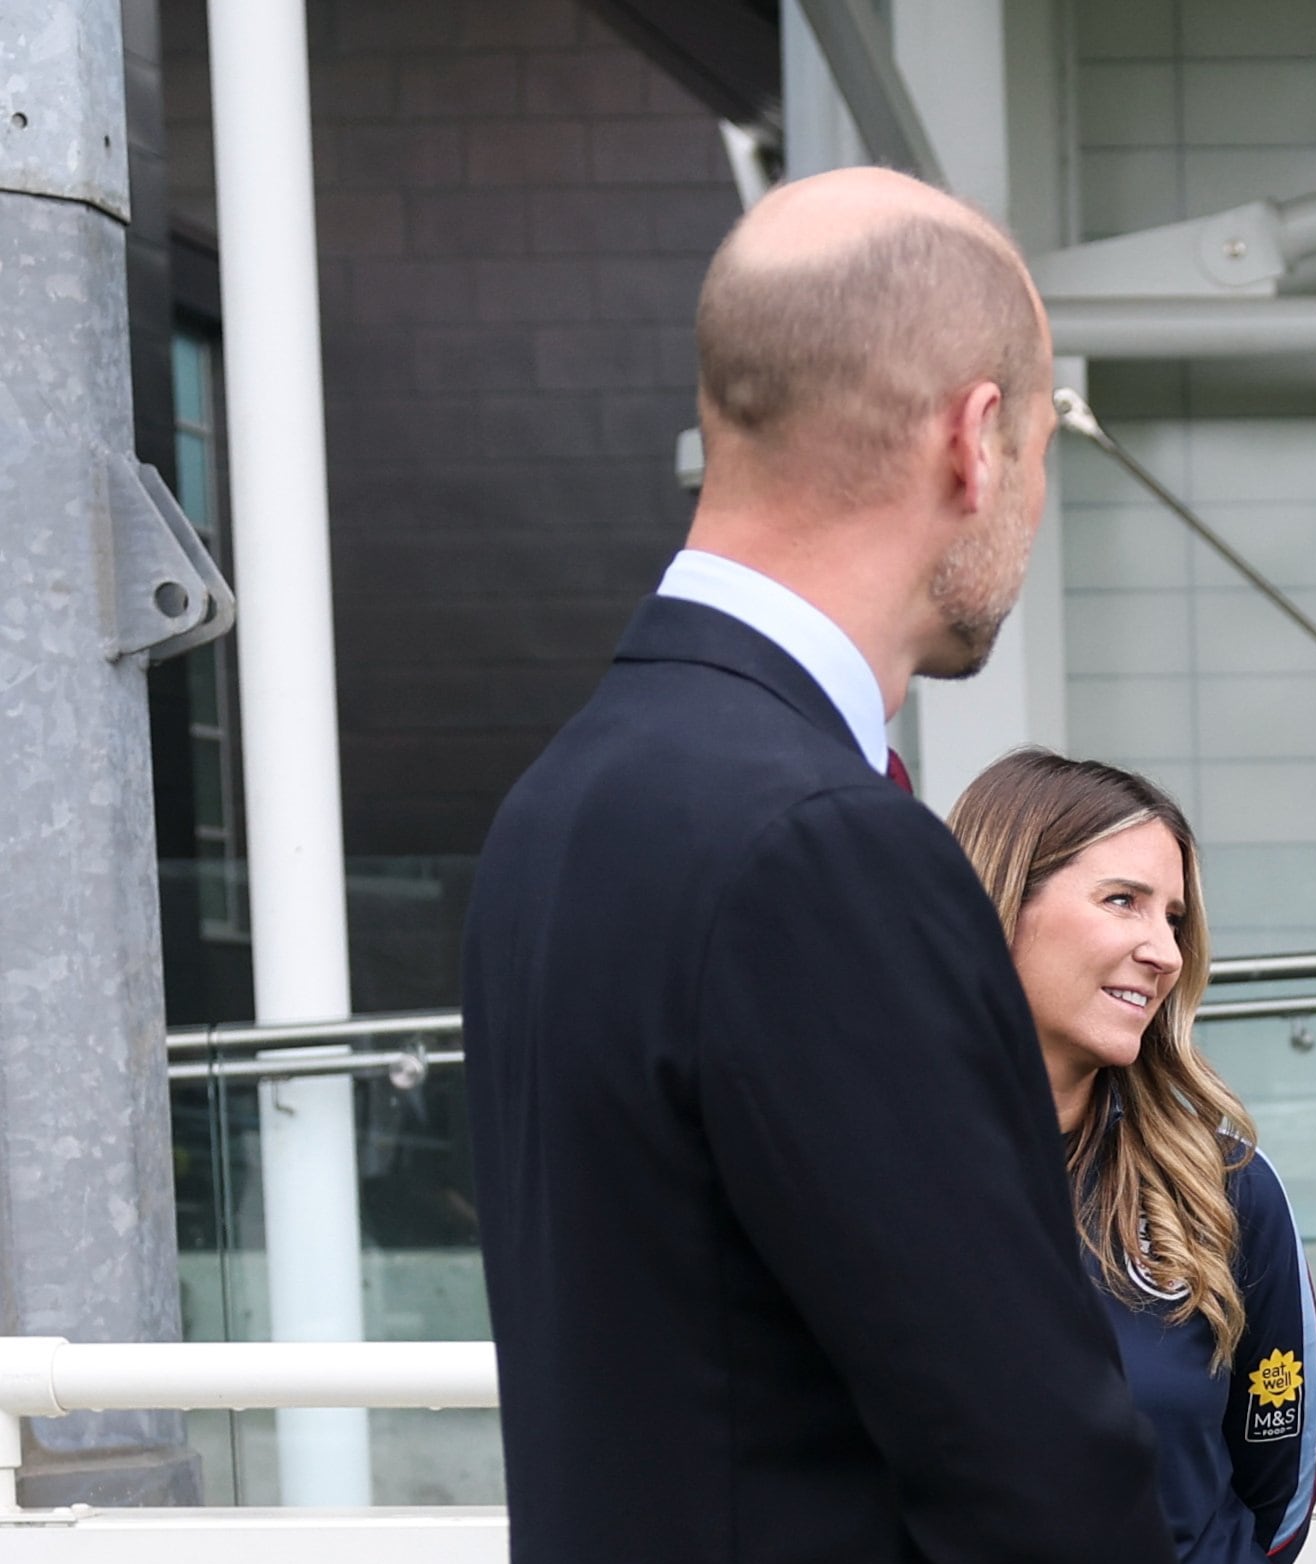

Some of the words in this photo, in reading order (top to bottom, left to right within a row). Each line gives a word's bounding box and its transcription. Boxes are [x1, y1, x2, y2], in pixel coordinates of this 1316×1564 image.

[1262, 1362, 1287, 1379] eat
[1263, 1371, 1292, 1390] well
[1254, 1408, 1296, 1428] M&S
[1262, 1427, 1286, 1436] FOOD
